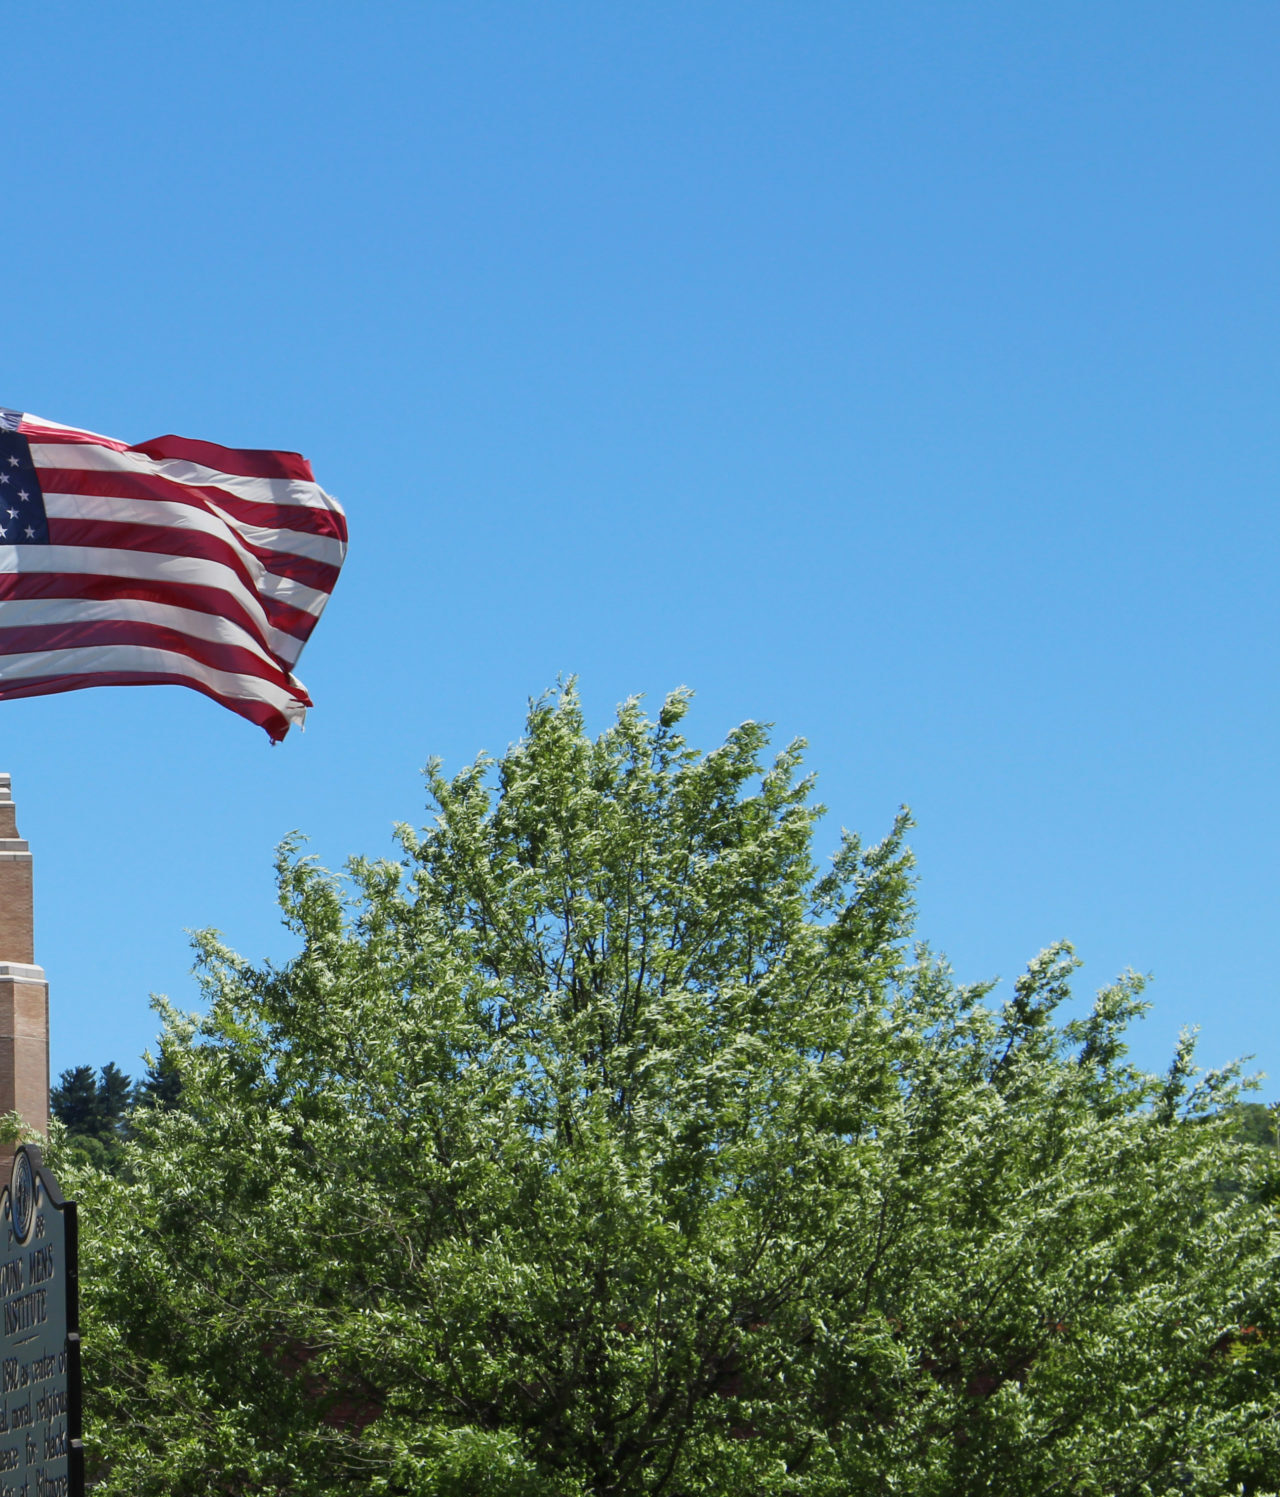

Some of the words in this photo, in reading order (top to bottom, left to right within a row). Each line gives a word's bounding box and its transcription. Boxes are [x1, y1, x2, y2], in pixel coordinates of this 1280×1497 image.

[4, 1287, 47, 1336] INSTITUTE
[31, 1346, 56, 1383] center
[12, 1390, 35, 1428] moral,
[25, 1432, 37, 1466] for
